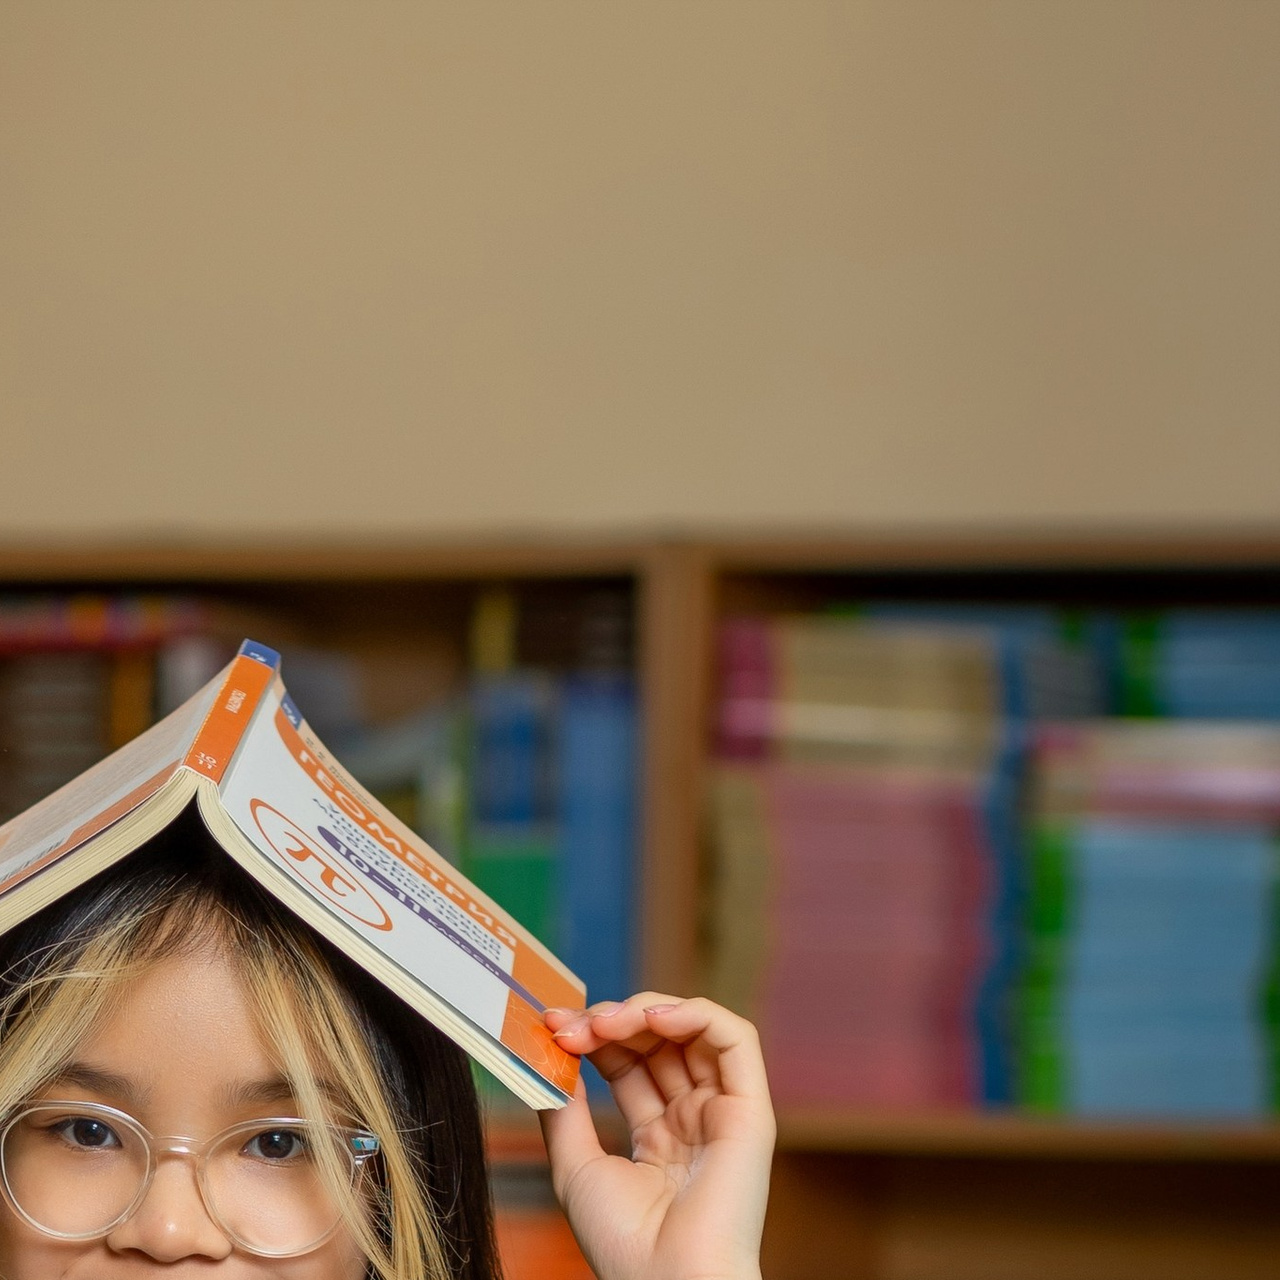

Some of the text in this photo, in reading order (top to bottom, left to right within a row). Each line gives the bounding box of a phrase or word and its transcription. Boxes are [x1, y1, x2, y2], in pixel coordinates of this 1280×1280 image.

[300, 749, 517, 948] ГЕОМЕТРИЯ
[313, 798, 501, 956] многоуровневый
[328, 803, 502, 950] Универсальный
[332, 824, 500, 961] сборник задач
[427, 917, 500, 976] классы
